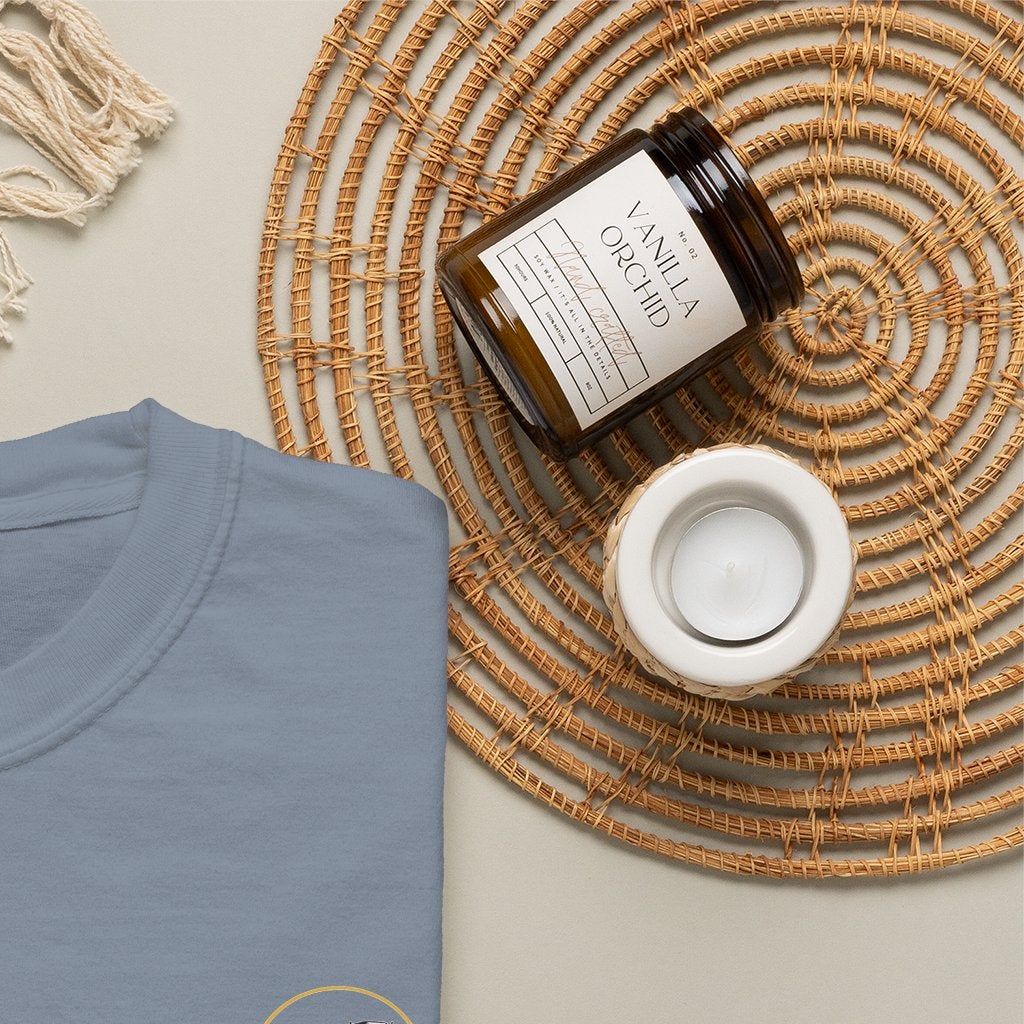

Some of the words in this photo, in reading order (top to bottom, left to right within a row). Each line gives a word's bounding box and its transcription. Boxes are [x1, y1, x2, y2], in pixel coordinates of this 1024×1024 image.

[600, 225, 670, 328] ORCHID
[627, 200, 700, 319] VANILLA
[678, 230, 688, 246] No.
[688, 248, 698, 260] 02
[534, 254, 544, 267] SOY
[544, 268, 555, 283] WAX
[558, 291, 570, 306] IT'S
[568, 309, 579, 322] ALL
[578, 324, 586, 334] IN
[585, 335, 595, 350] THE
[593, 351, 611, 380] DETAILS
[553, 323, 567, 344] NATURAL
